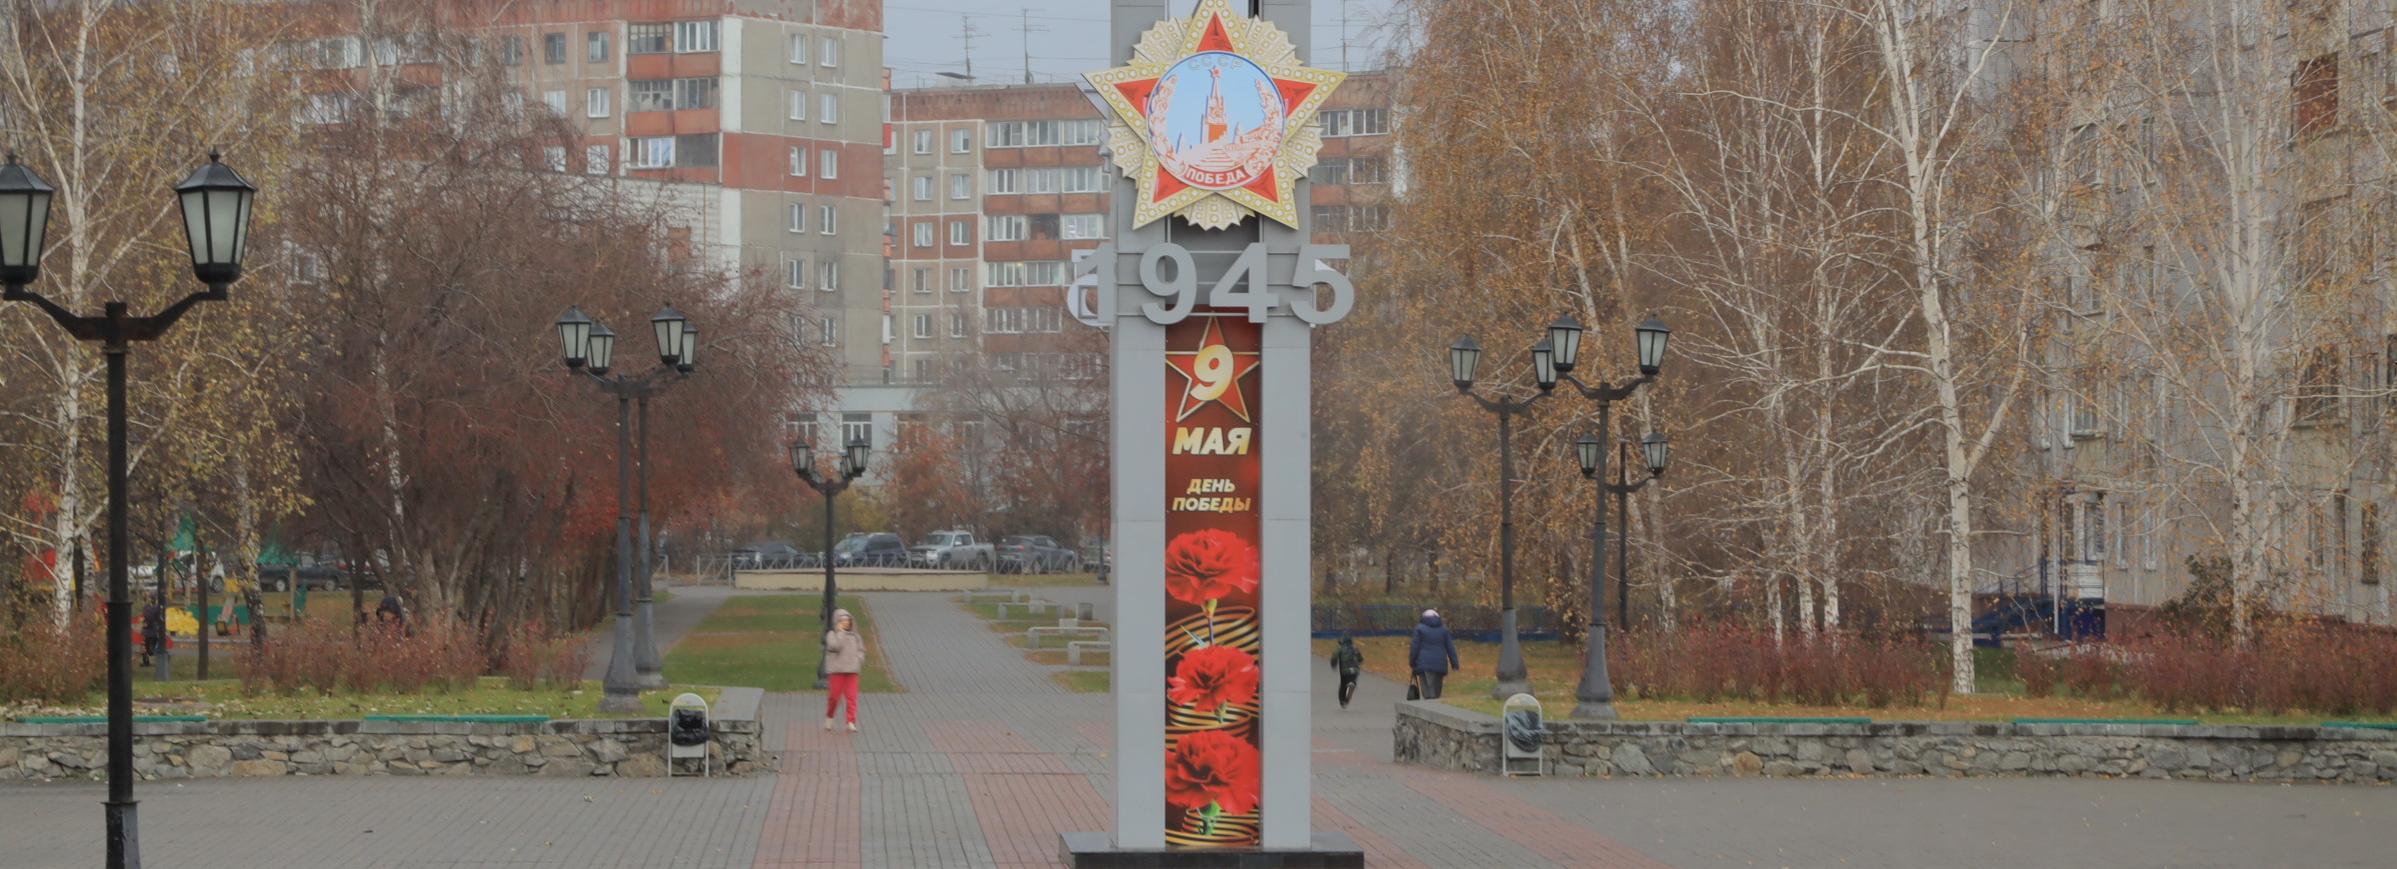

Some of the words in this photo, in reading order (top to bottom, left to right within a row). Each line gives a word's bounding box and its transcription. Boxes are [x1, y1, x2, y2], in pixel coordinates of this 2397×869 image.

[1185, 168, 1246, 184] ПОБЕДА
[1076, 242, 1354, 324] 1945
[1190, 344, 1234, 401] 9
[1172, 427, 1252, 455] МАЯ
[1187, 479, 1235, 494] ДЕНЬ
[1172, 498, 1251, 513] ПОБЕДЫ
